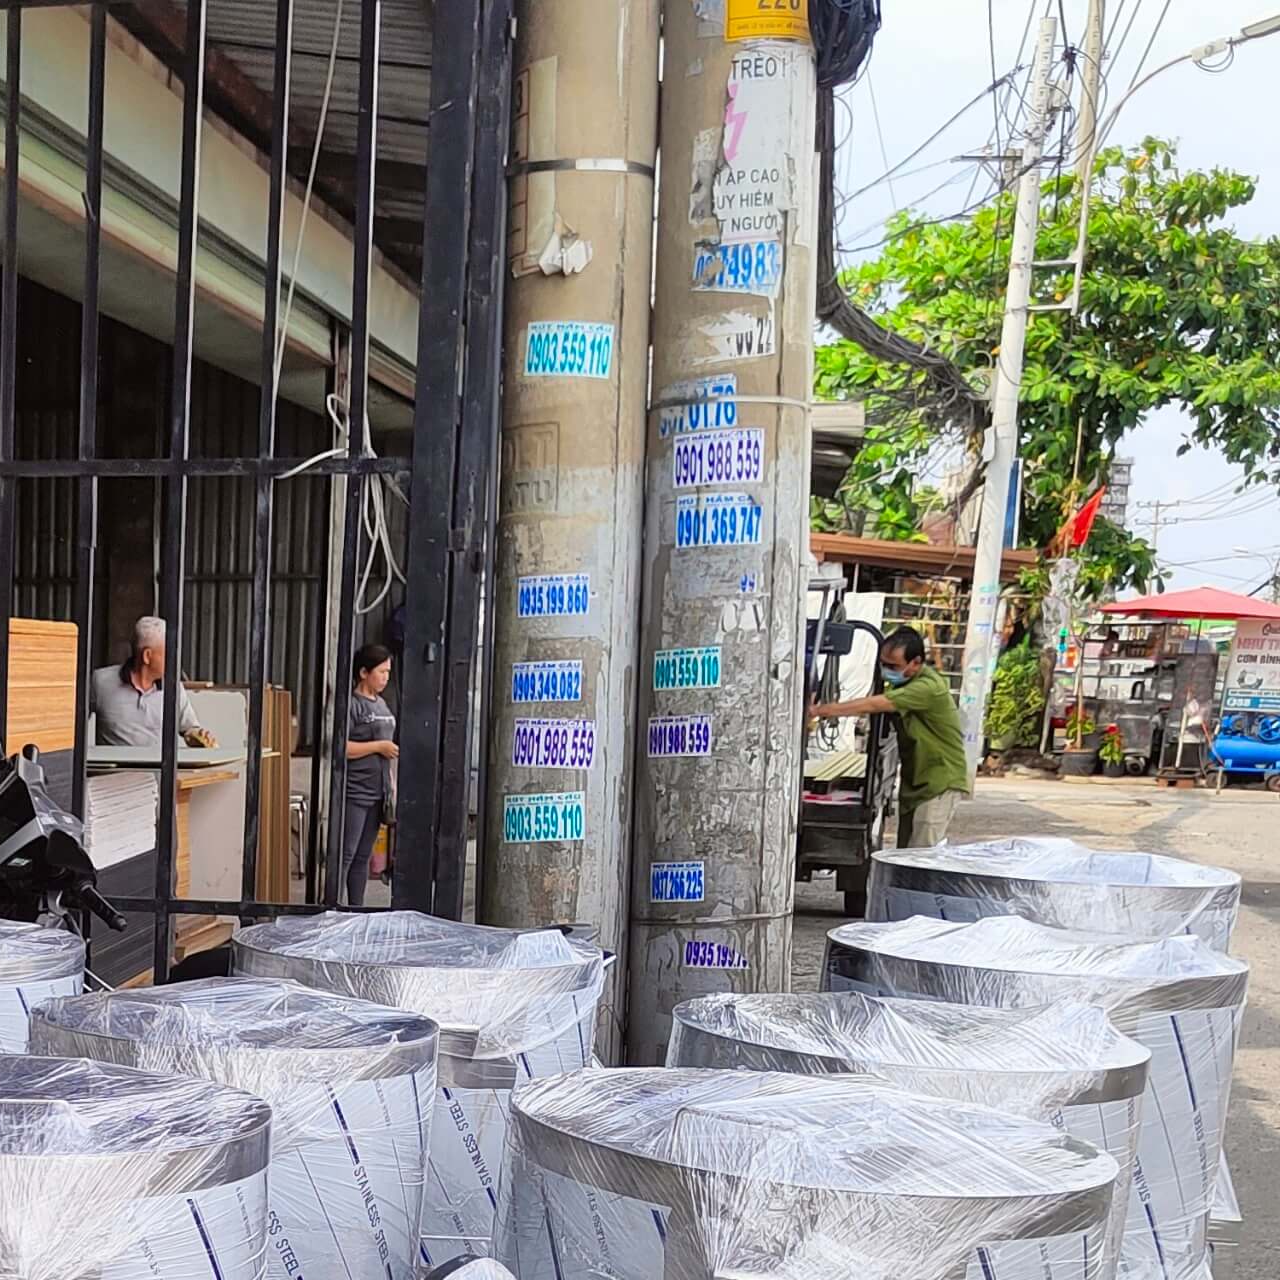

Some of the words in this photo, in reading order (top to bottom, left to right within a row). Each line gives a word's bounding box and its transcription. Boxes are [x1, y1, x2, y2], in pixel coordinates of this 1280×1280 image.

[750, 168, 780, 184] CAO
[717, 194, 735, 209] UY
[527, 331, 610, 374] 0903.559.110
[675, 438, 760, 486] 0901.988.559
[677, 505, 762, 547] 0901.369.747
[519, 585, 588, 616] 0935.199.860
[513, 671, 580, 701] 0909.349.082
[514, 727, 594, 768] 0901.988.559
[505, 805, 582, 841] 0903.559.110
[449, 1101, 470, 1132] STEEL
[463, 1133, 493, 1187] STAINLESS
[353, 1165, 381, 1229] STAINLESS
[374, 1227, 390, 1267] STEEL
[275, 1237, 300, 1277] STEEL
